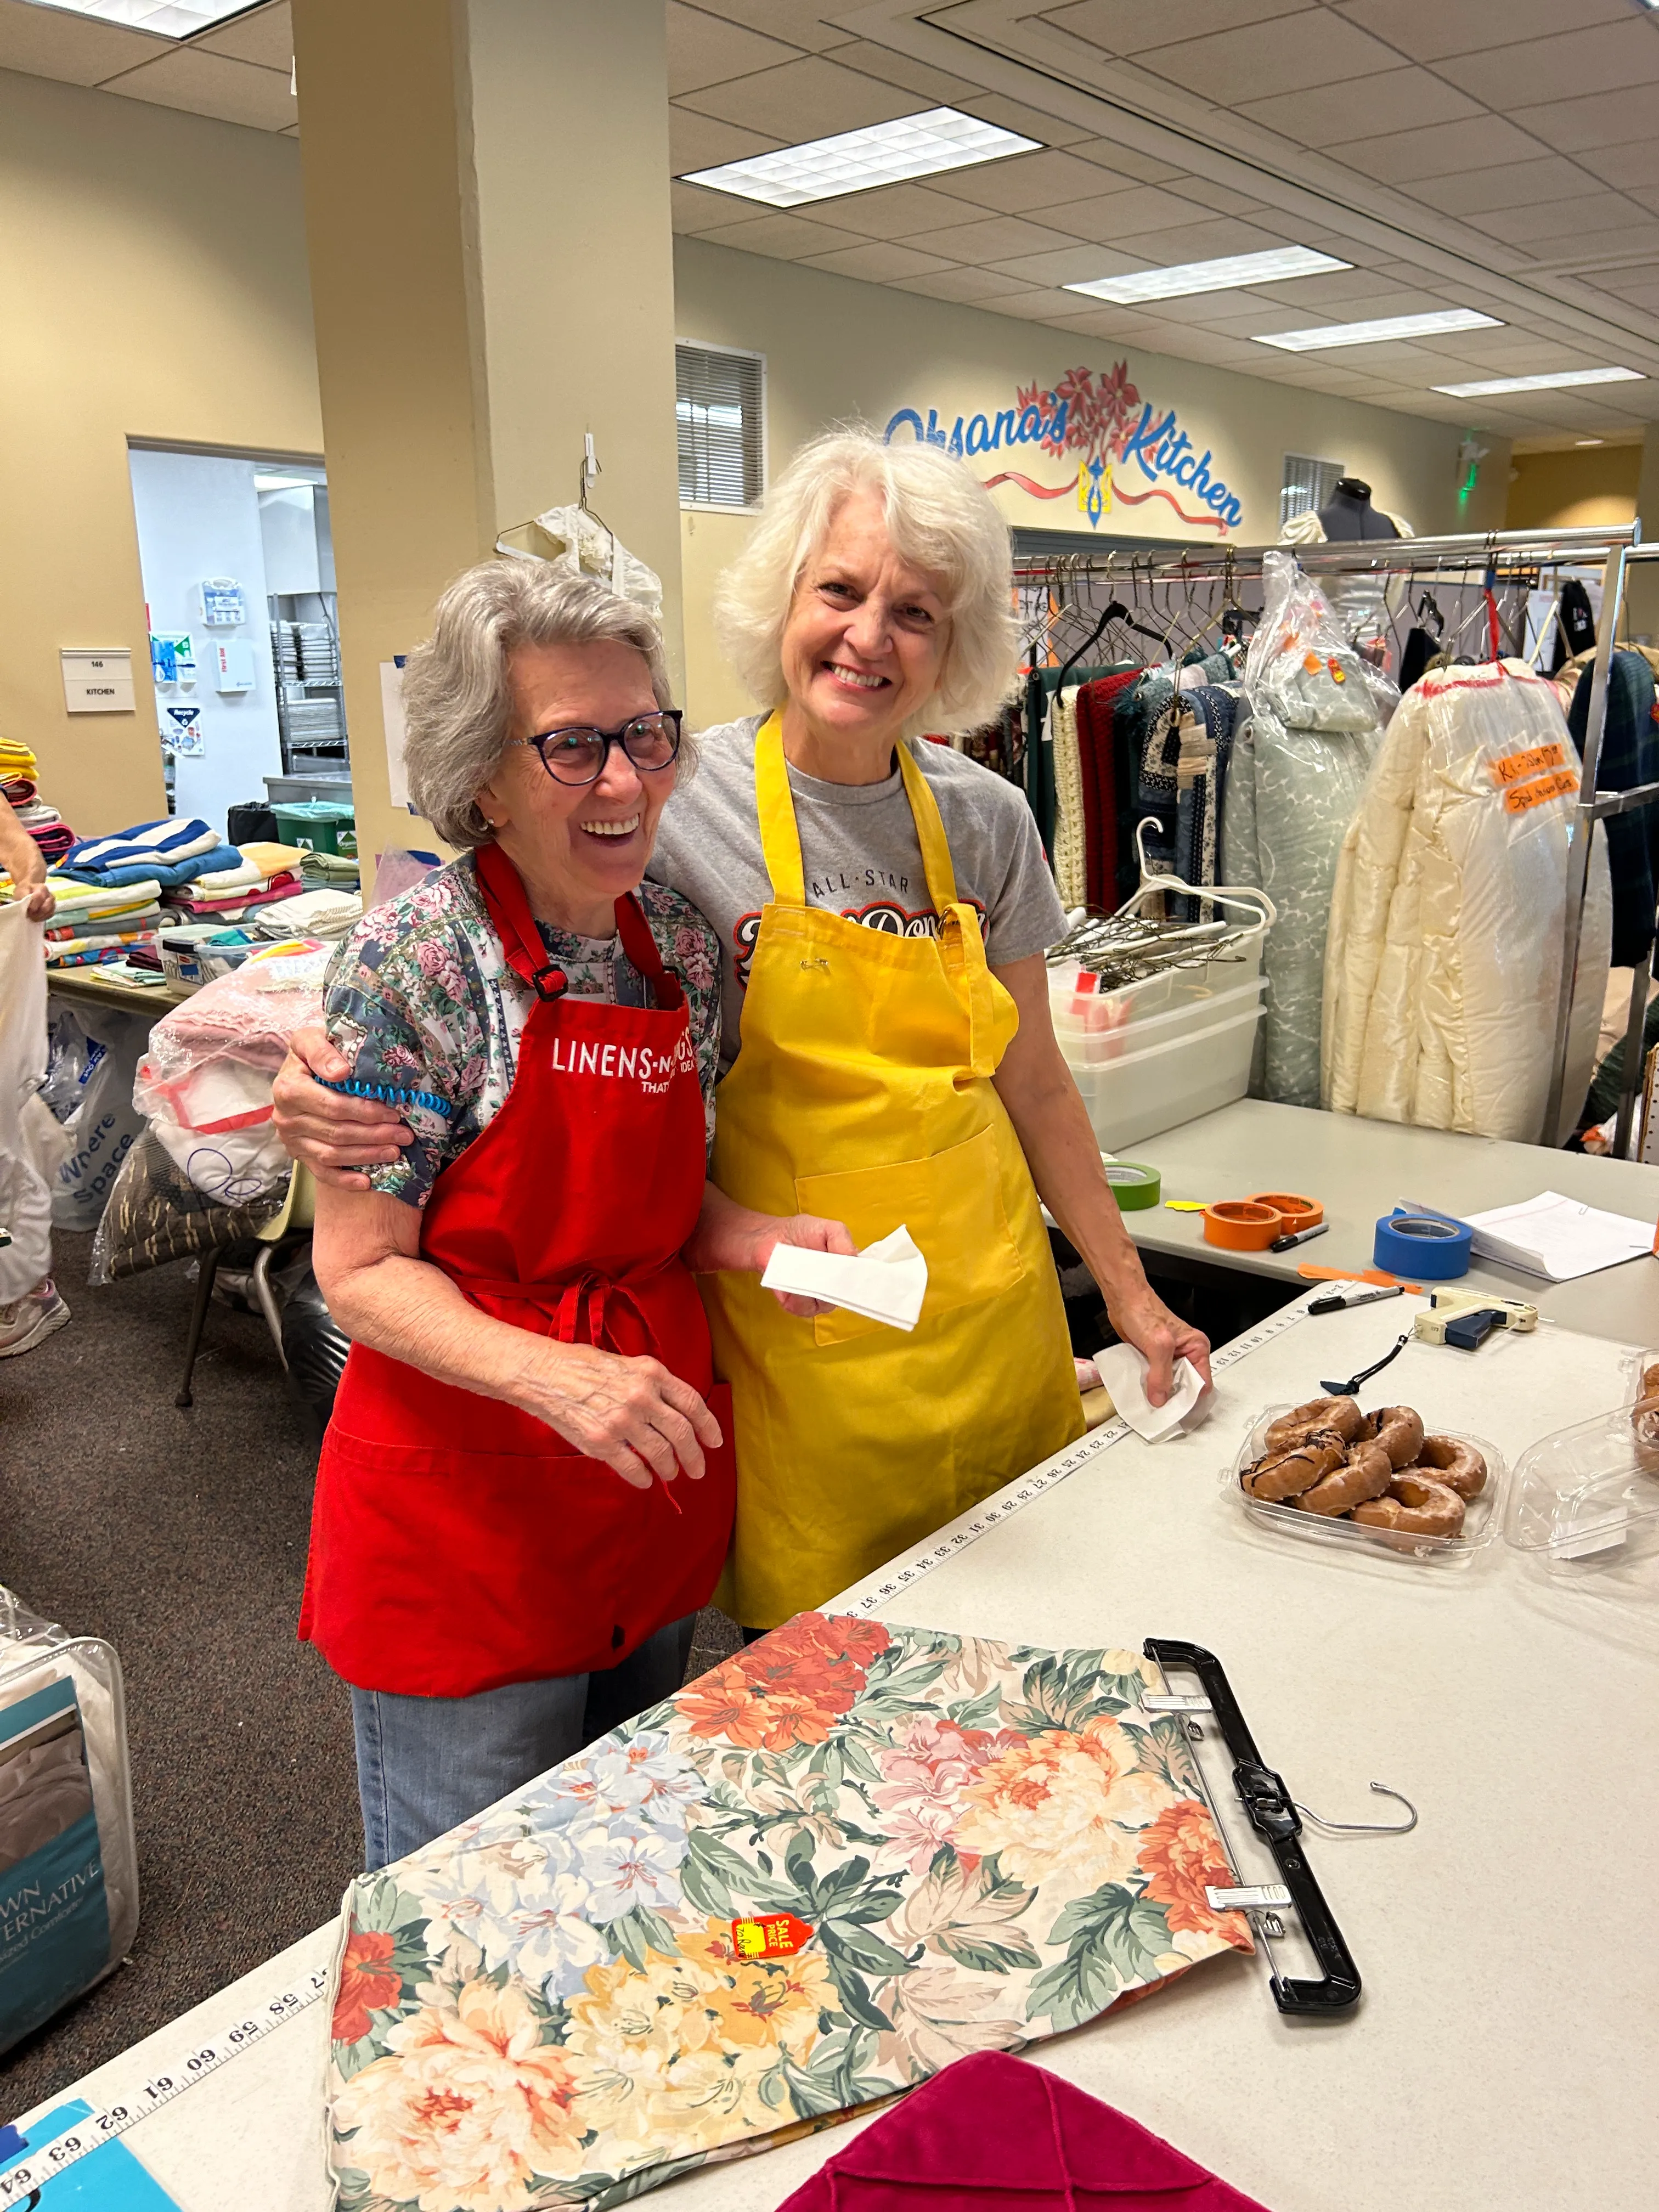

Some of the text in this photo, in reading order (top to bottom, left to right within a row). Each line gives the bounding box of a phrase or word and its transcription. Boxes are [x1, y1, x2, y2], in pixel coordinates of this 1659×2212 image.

[1121, 403, 1242, 527] Kitchen
[1216, 1357, 1229, 1365] 13
[1103, 1430, 1118, 1438] 22
[1090, 1440, 1104, 1449] 23
[1075, 1449, 1091, 1459] 24
[1062, 1459, 1076, 1468] 25
[1047, 1469, 1062, 1478] 26
[1032, 1479, 1048, 1489] 27
[1017, 1490, 1032, 1500] 28
[1001, 1500, 1017, 1510] 29
[985, 1511, 1001, 1522] 30
[968, 1523, 985, 1532] 31
[950, 1534, 968, 1544] 32
[934, 1546, 951, 1556] 33
[916, 1559, 933, 1569] 34
[898, 1571, 915, 1582] 35
[879, 1583, 896, 1594] 36
[860, 1596, 878, 1609] 37
[0, 1858, 100, 1941] ERNATIVE
[766, 1924, 778, 1948] PRICE
[776, 1920, 794, 1949] SALE
[269, 1993, 299, 2015] 58
[228, 2021, 259, 2043] 59
[187, 2049, 216, 2070] 60
[142, 2076, 174, 2099] 61
[95, 2107, 128, 2130] 62
[48, 2137, 81, 2161] 63
[0, 2169, 31, 2194] 64
